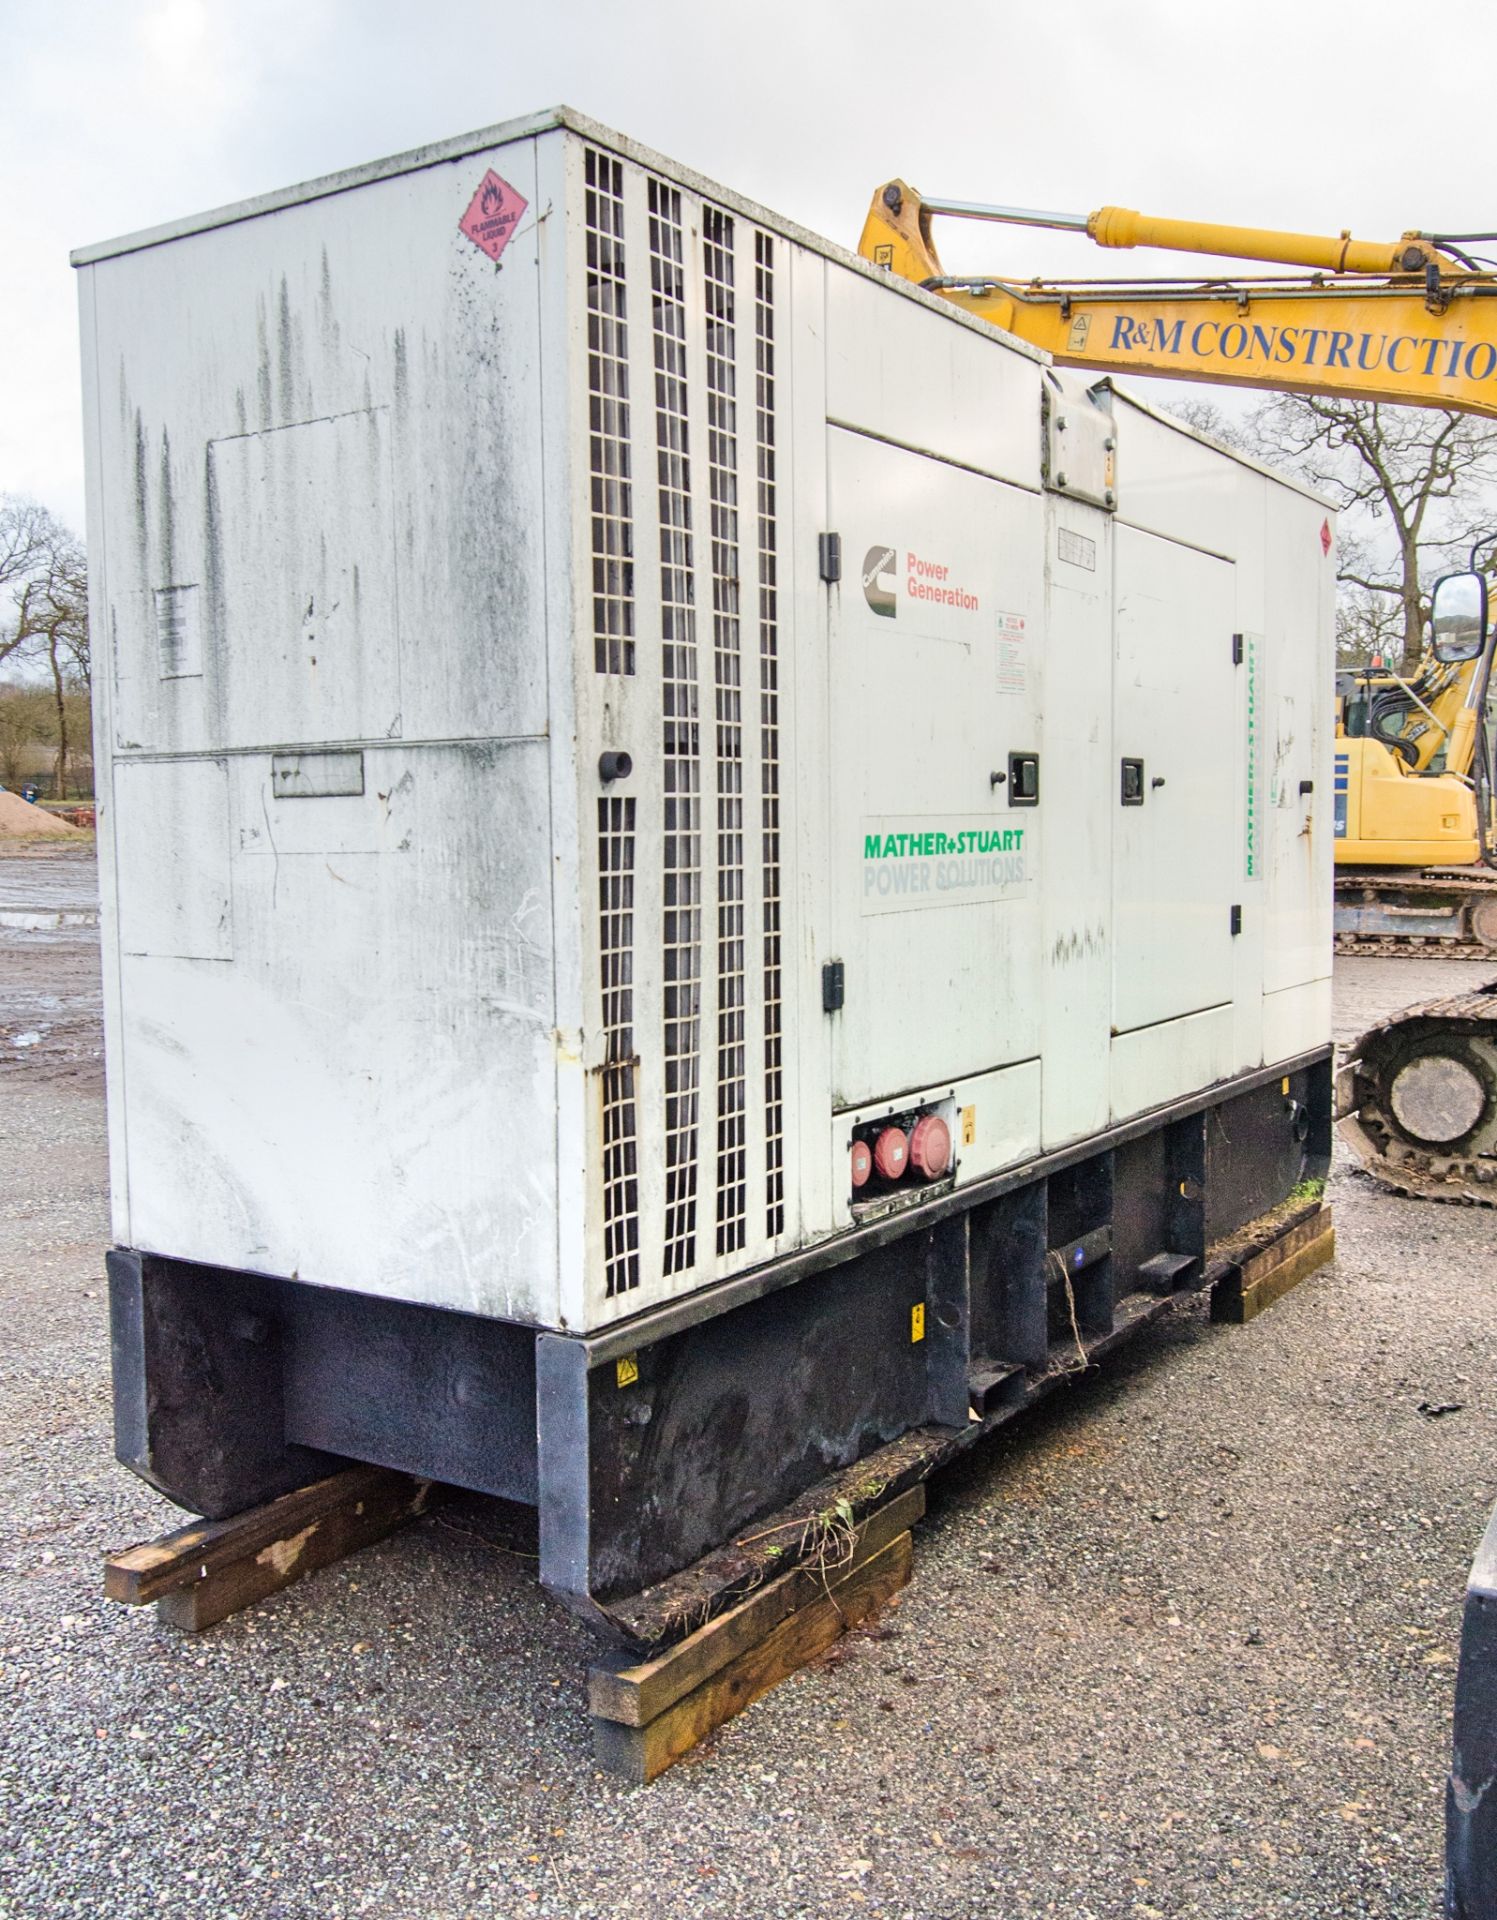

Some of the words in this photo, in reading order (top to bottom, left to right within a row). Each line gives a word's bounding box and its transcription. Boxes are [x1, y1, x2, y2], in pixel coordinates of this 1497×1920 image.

[471, 211, 516, 235] FLAMMABLE
[483, 226, 506, 242] LIQUID
[1109, 315, 1187, 354] R&M
[1191, 321, 1497, 381] CONSTRUCTIO
[863, 549, 895, 588] Cummins
[907, 552, 949, 581] Power
[907, 576, 979, 611] Generation
[863, 862, 931, 897] POWER
[935, 856, 1025, 891] SOLUTIONS
